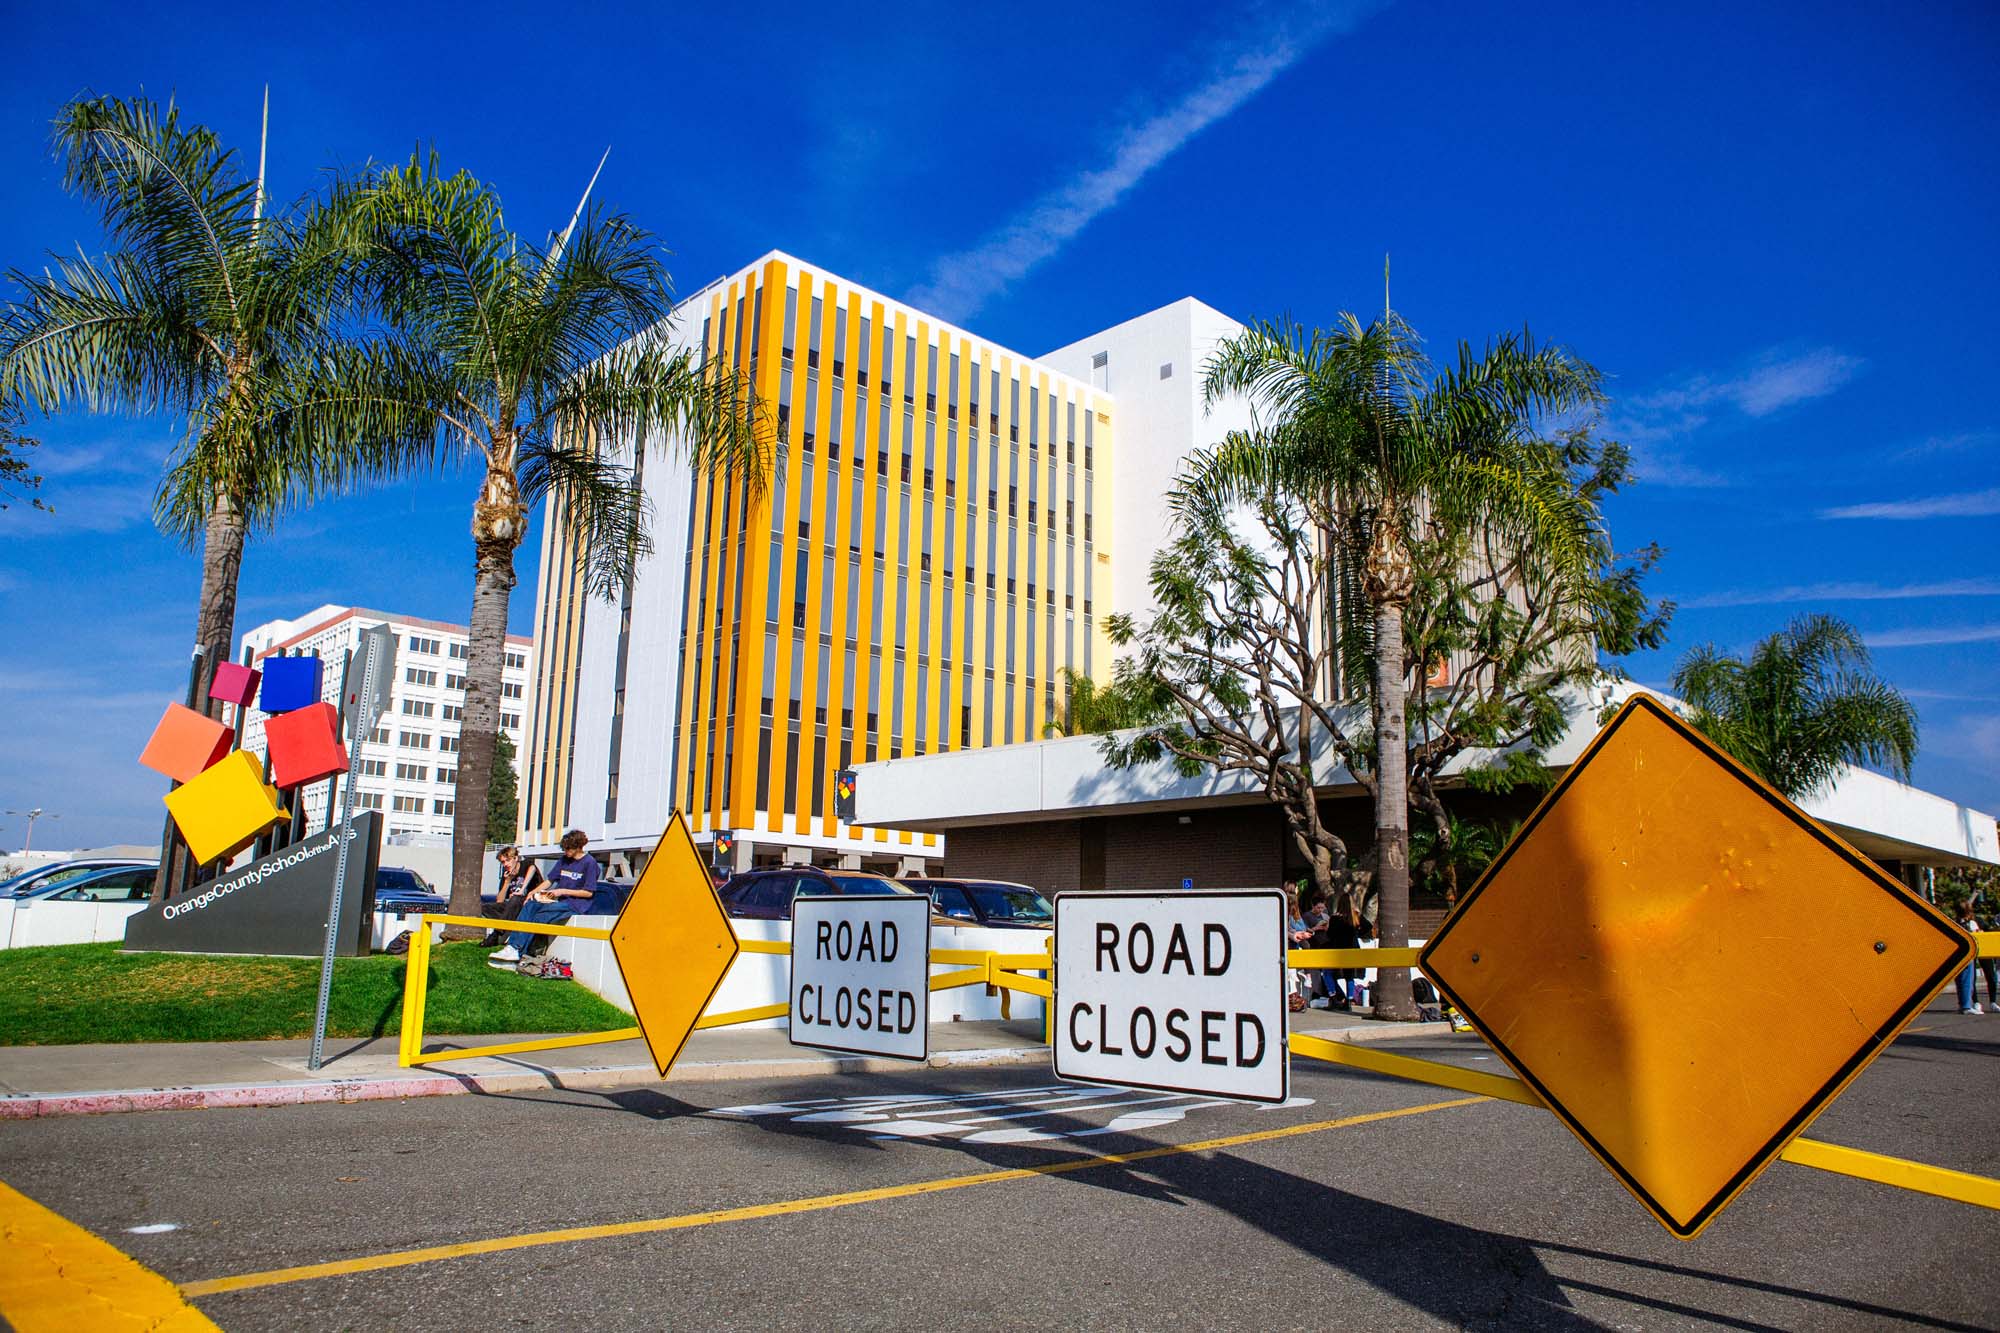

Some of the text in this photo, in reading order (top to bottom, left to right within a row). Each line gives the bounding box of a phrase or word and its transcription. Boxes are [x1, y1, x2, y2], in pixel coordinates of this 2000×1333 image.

[162, 828, 358, 921] OrangeCountySchooloftheAs
[816, 920, 899, 963] ROAD
[1095, 921, 1232, 977] ROAD
[799, 983, 917, 1035] CLOSED
[1069, 1001, 1267, 1068] CLOSED
